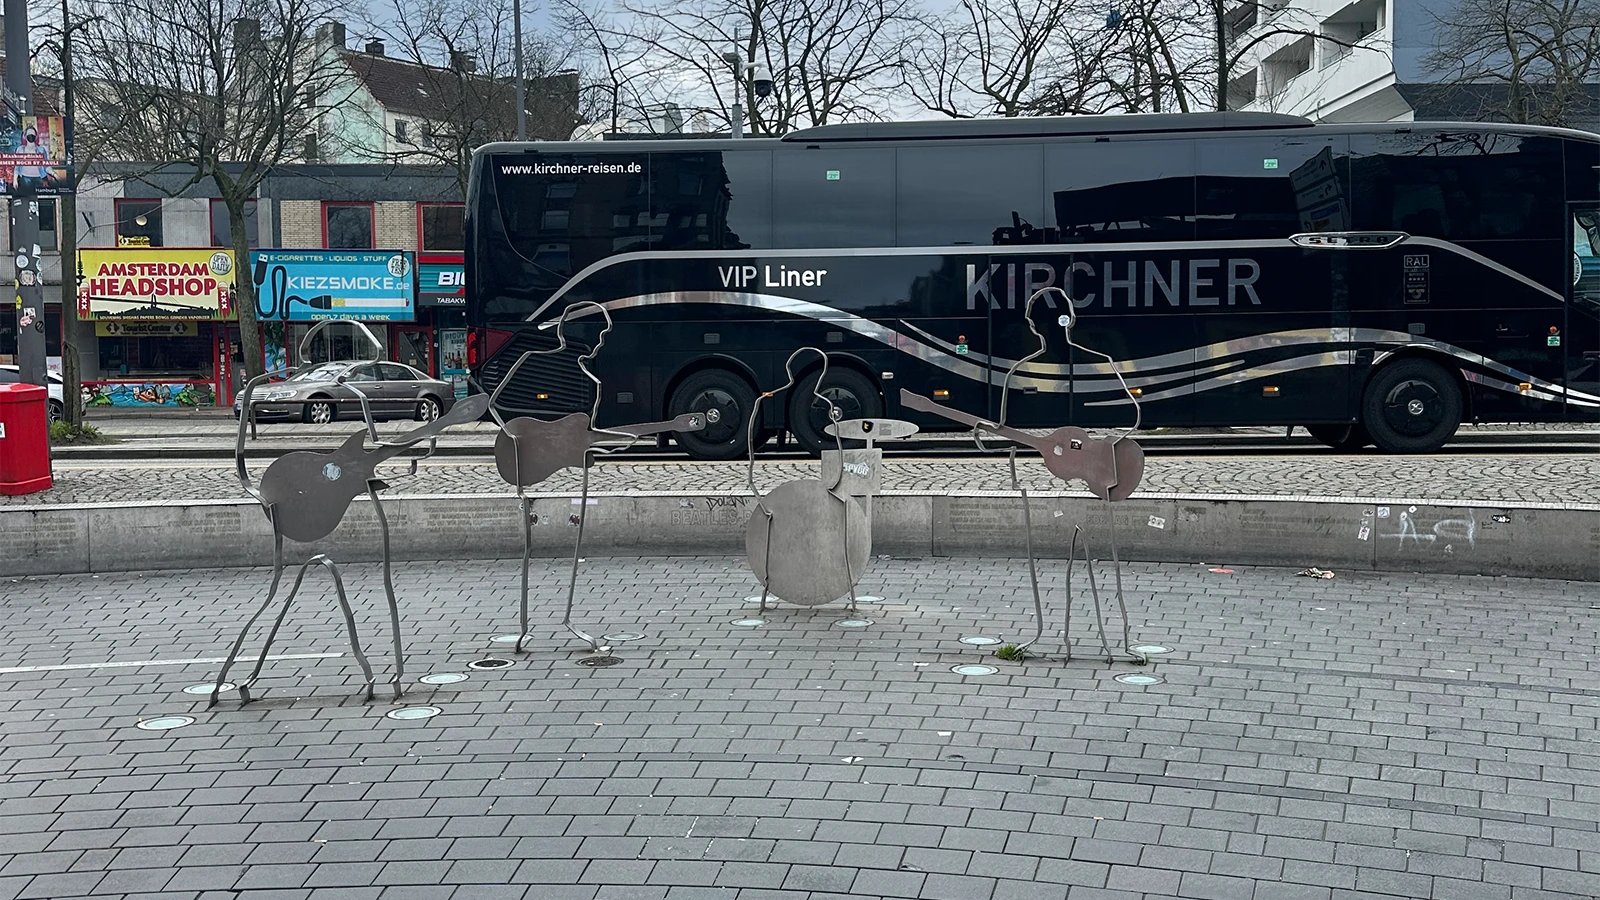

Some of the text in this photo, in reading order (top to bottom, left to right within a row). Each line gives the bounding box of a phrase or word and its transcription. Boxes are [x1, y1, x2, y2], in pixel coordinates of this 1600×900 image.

[501, 162, 642, 176] www.kirchner-reisen.de
[1406, 257, 1427, 266] RAL
[97, 263, 210, 277] AMSTERDAM
[717, 264, 828, 288] VIP Liner
[90, 278, 217, 296] HEADSHOP
[287, 276, 410, 290] KIEZSMOKE.de
[966, 257, 1262, 310] KIRCHNER
[121, 324, 172, 332] Tourist Center
